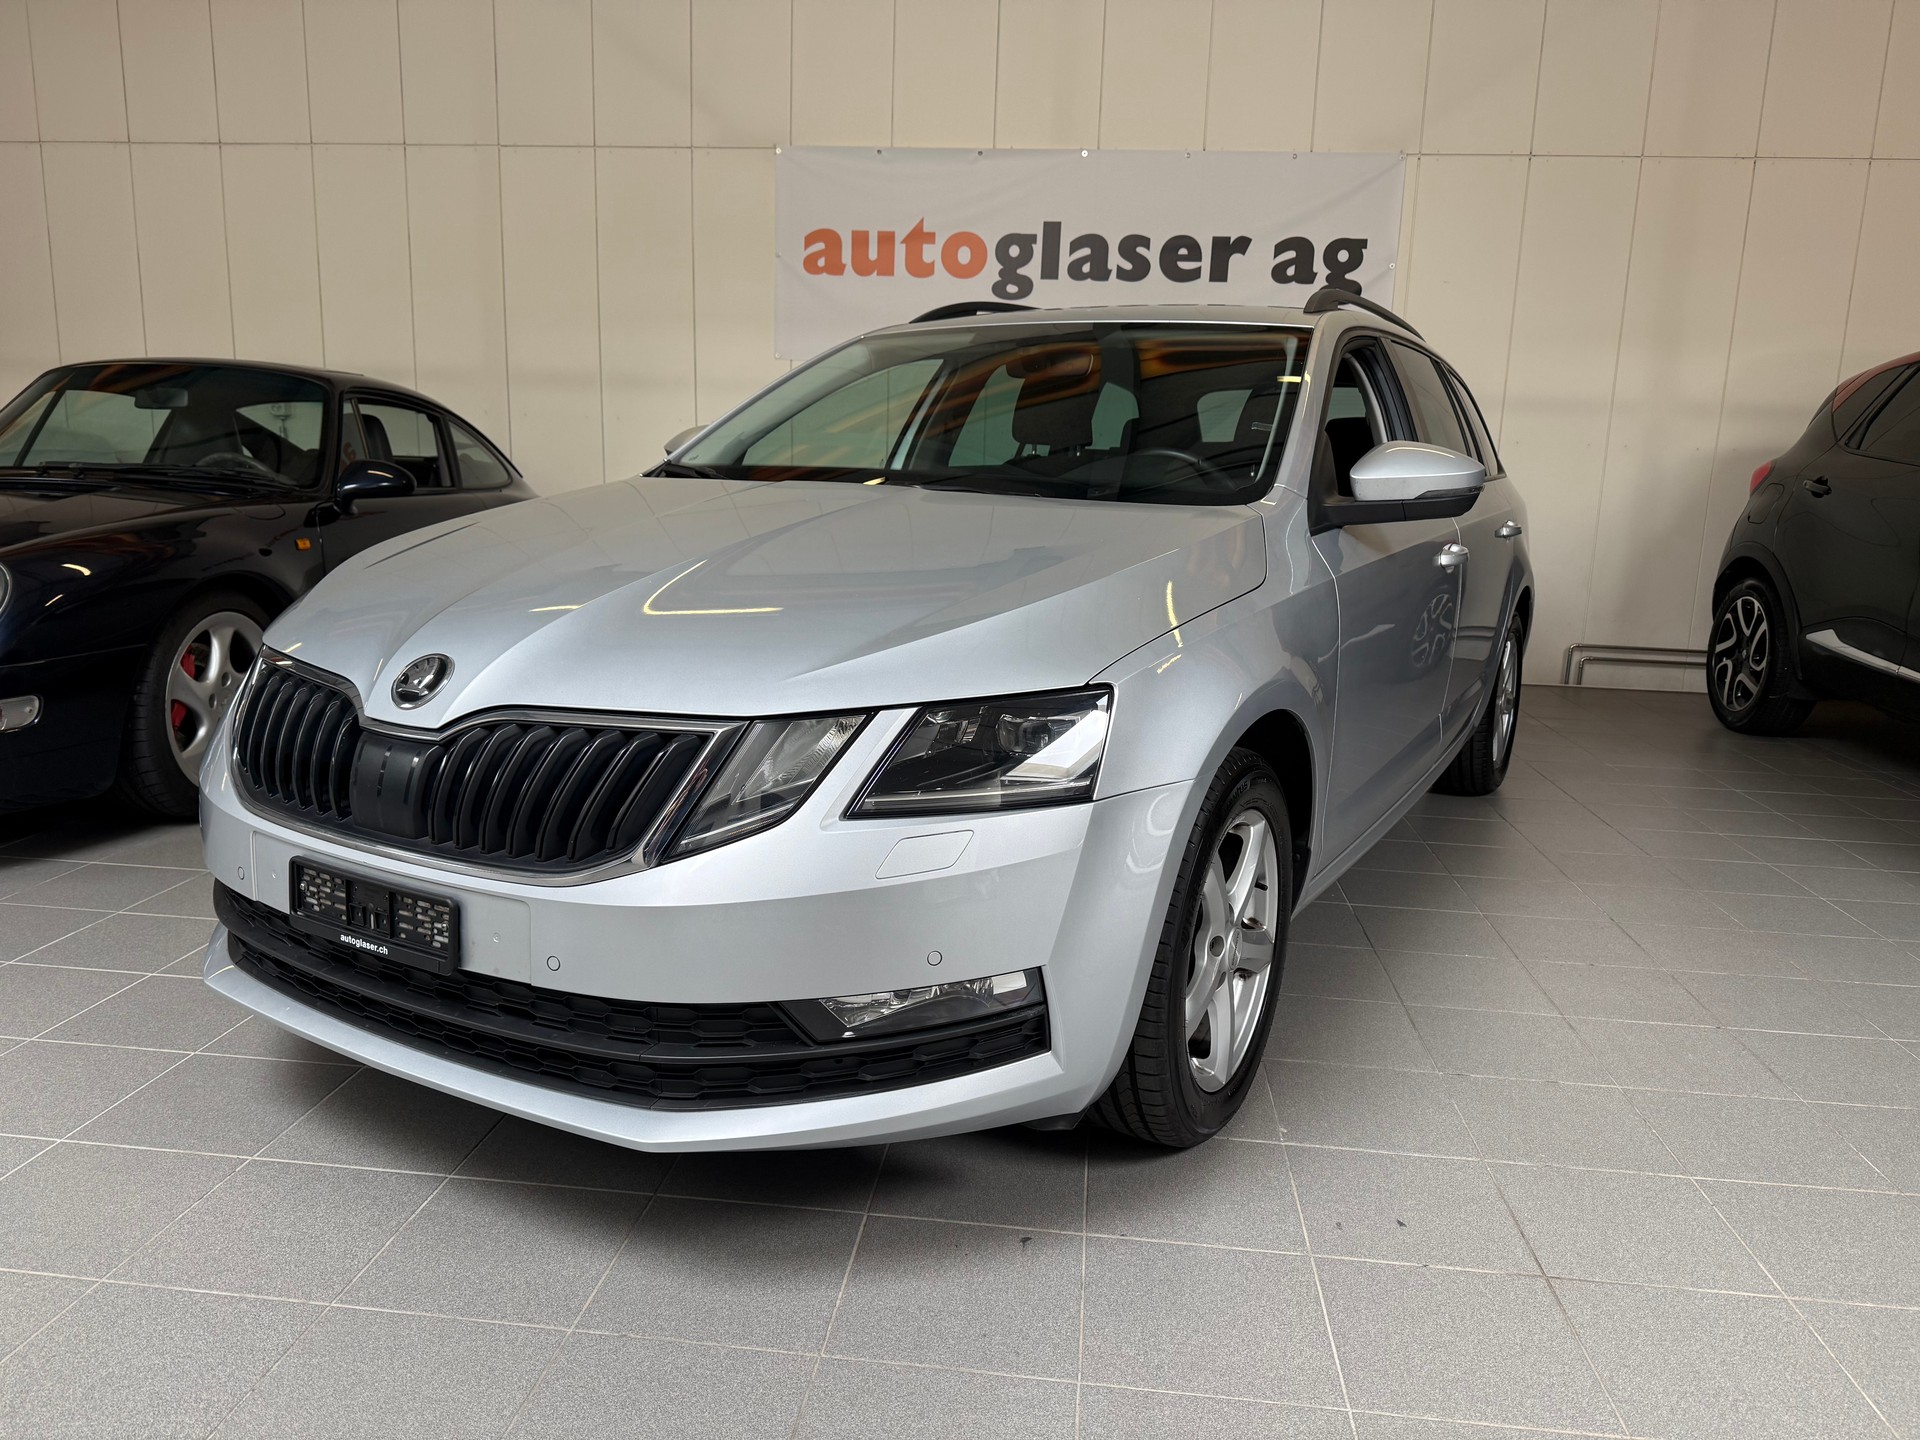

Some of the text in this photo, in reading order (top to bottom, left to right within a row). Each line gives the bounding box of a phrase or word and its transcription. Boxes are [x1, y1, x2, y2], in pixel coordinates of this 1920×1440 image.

[803, 217, 1368, 300] autoglaser ag
[340, 934, 388, 955] autoglaser.ch
